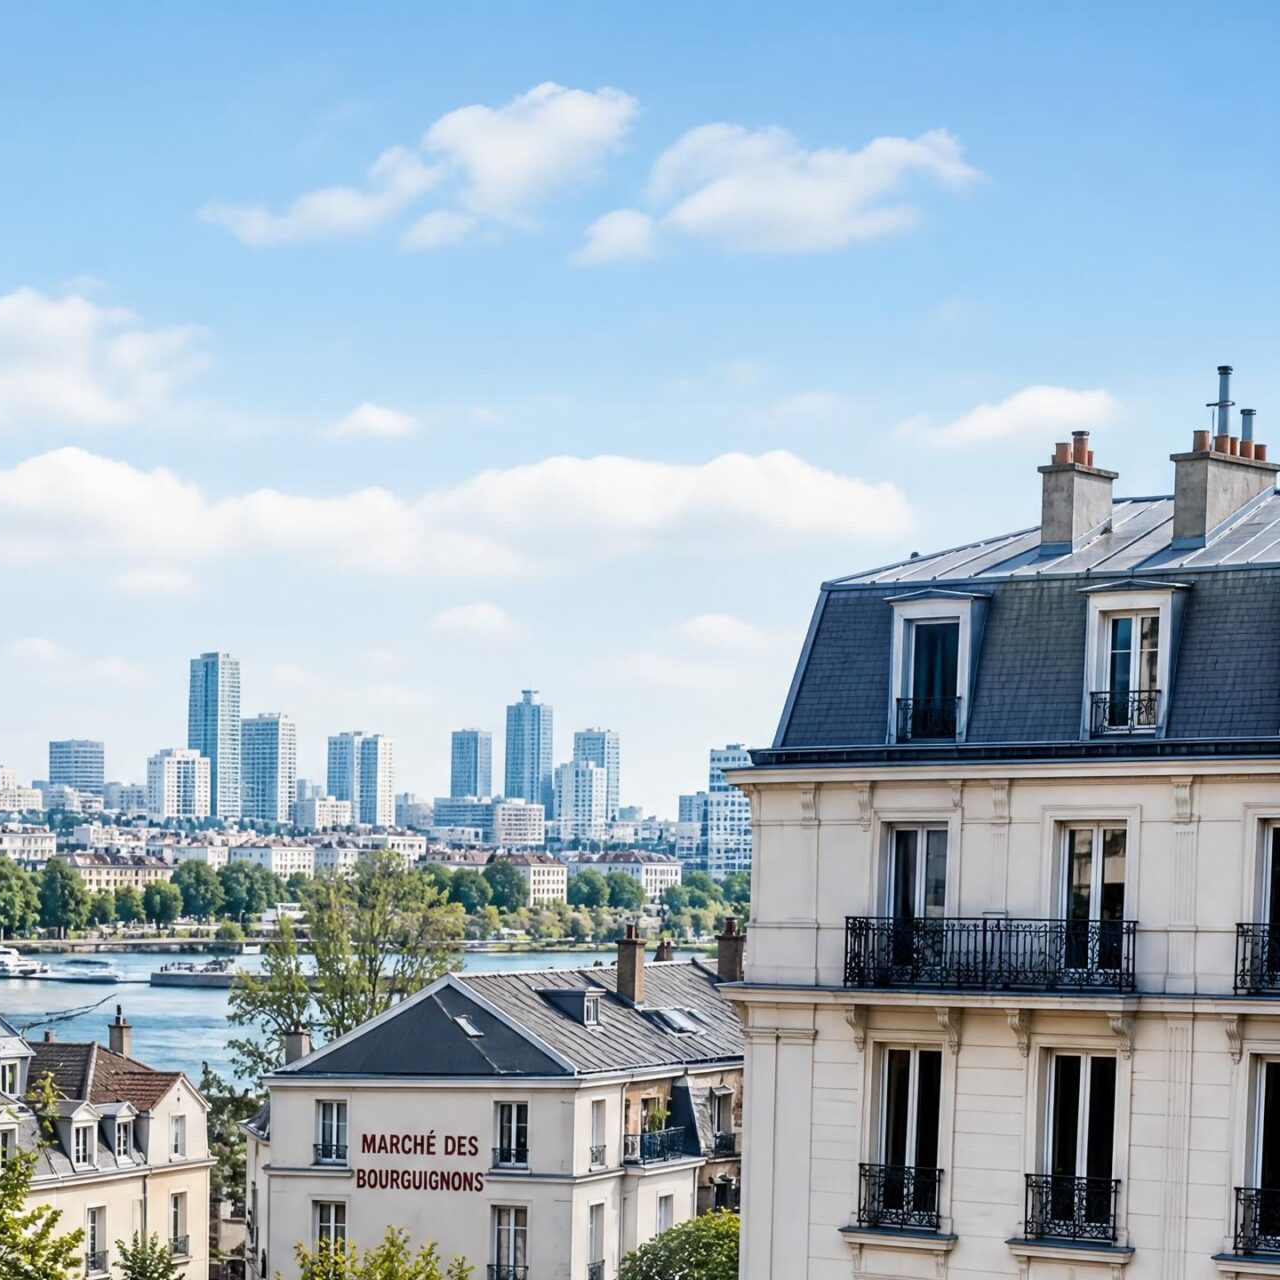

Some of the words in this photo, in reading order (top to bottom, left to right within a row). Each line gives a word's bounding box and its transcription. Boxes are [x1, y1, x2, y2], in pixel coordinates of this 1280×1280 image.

[361, 1129, 437, 1156] MARCHÉ
[444, 1135, 479, 1157] DES
[355, 1168, 485, 1193] BOURGUIGNONS
